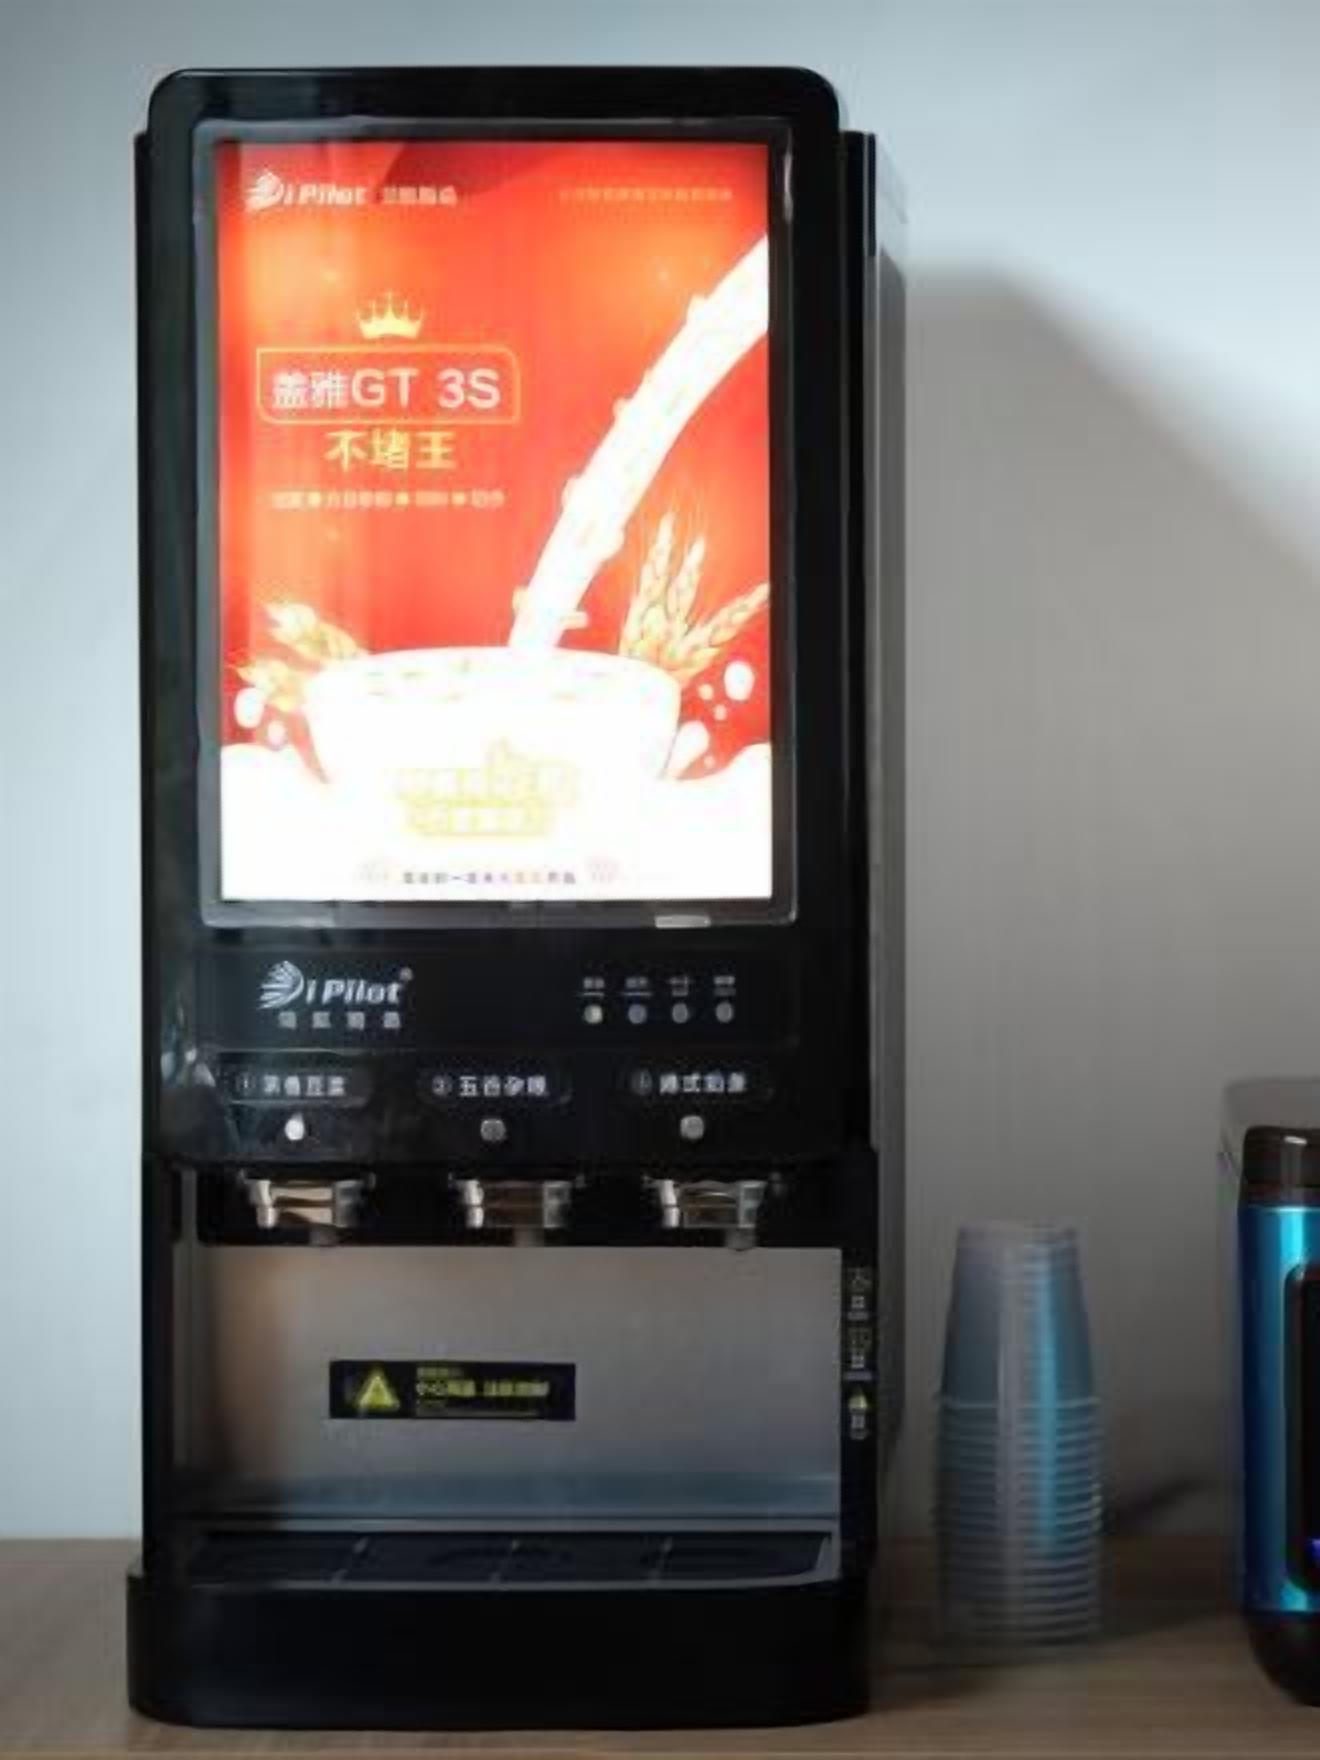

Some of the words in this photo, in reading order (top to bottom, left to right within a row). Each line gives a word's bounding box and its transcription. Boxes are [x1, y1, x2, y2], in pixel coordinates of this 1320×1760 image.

[437, 368, 502, 409] 3S
[324, 429, 457, 472] 不堵王
